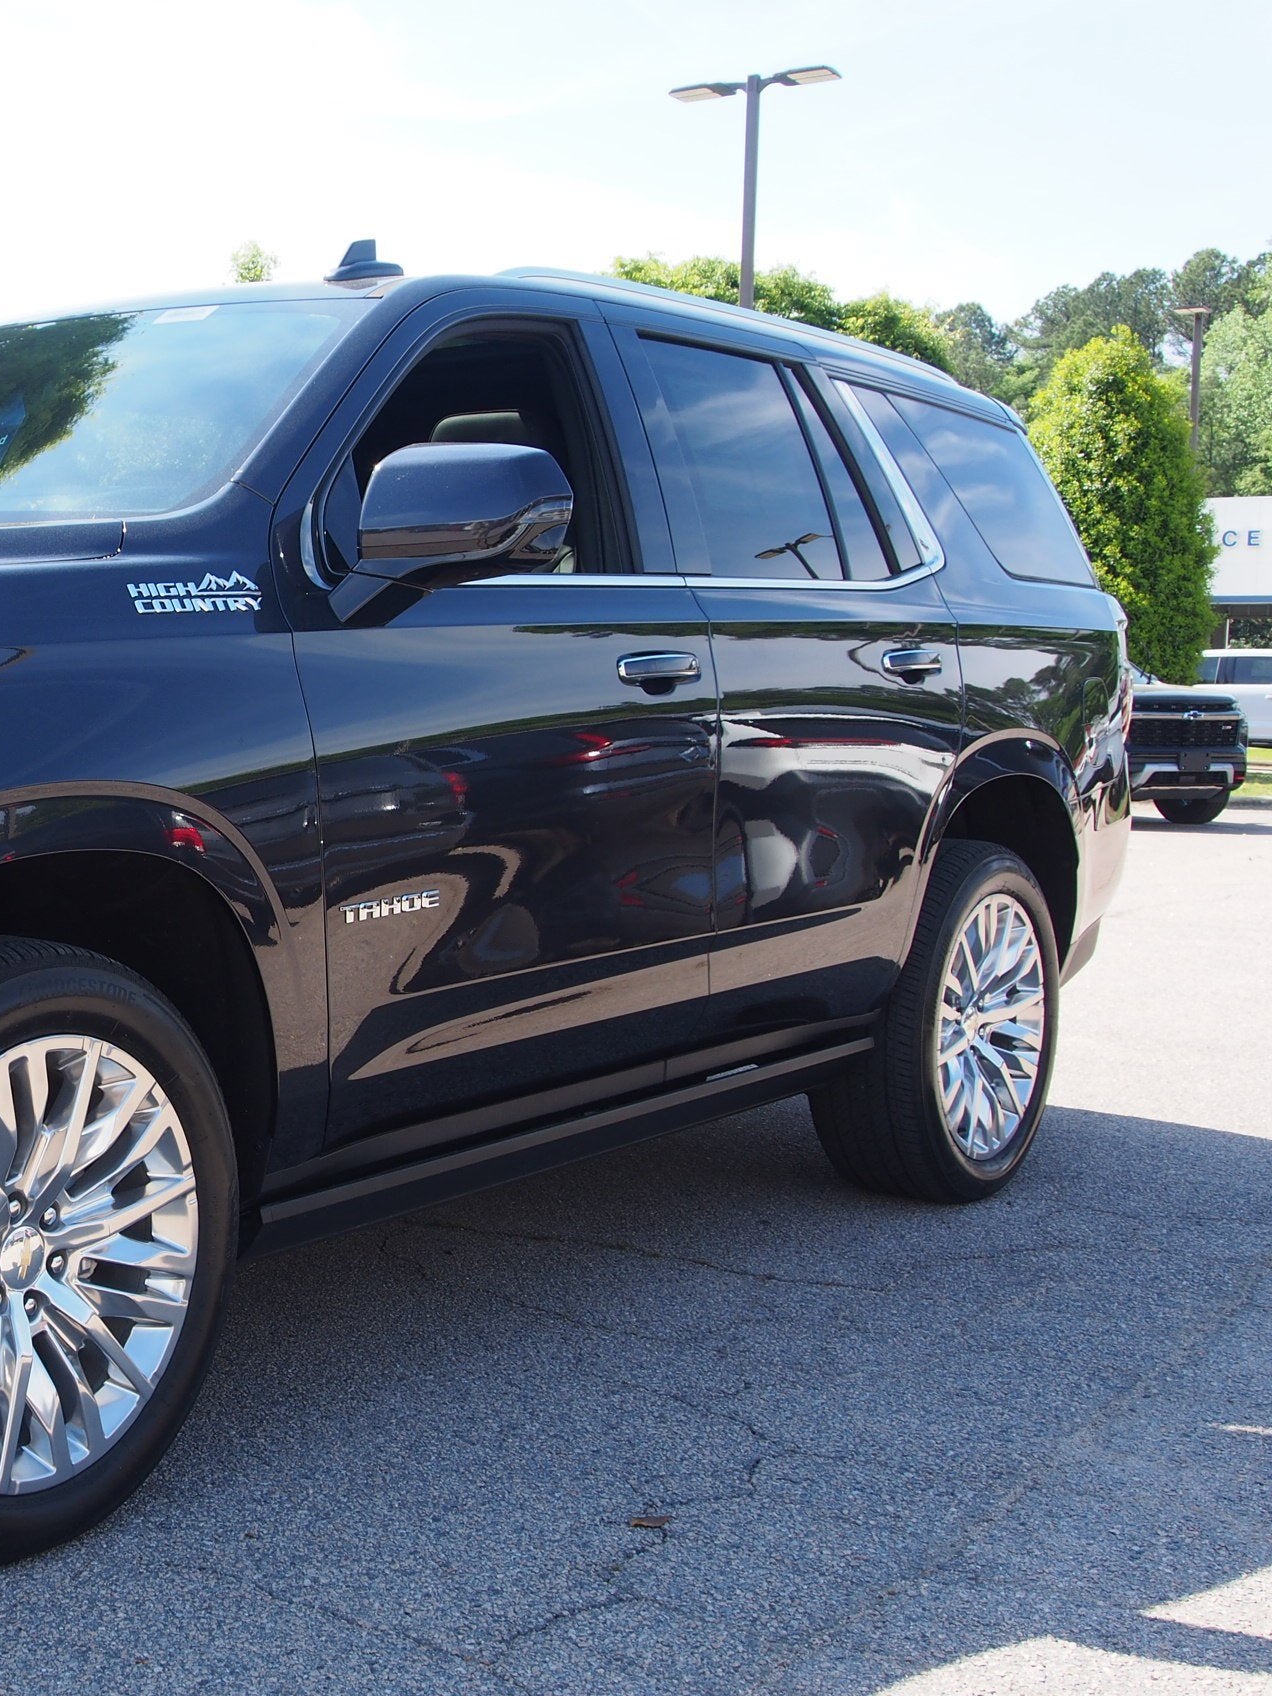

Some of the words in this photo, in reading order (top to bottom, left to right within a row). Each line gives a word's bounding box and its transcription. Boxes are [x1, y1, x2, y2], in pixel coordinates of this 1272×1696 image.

[126, 582, 198, 598] HIGH
[134, 597, 262, 614] COUNTRY
[339, 889, 440, 924] TAHOE
